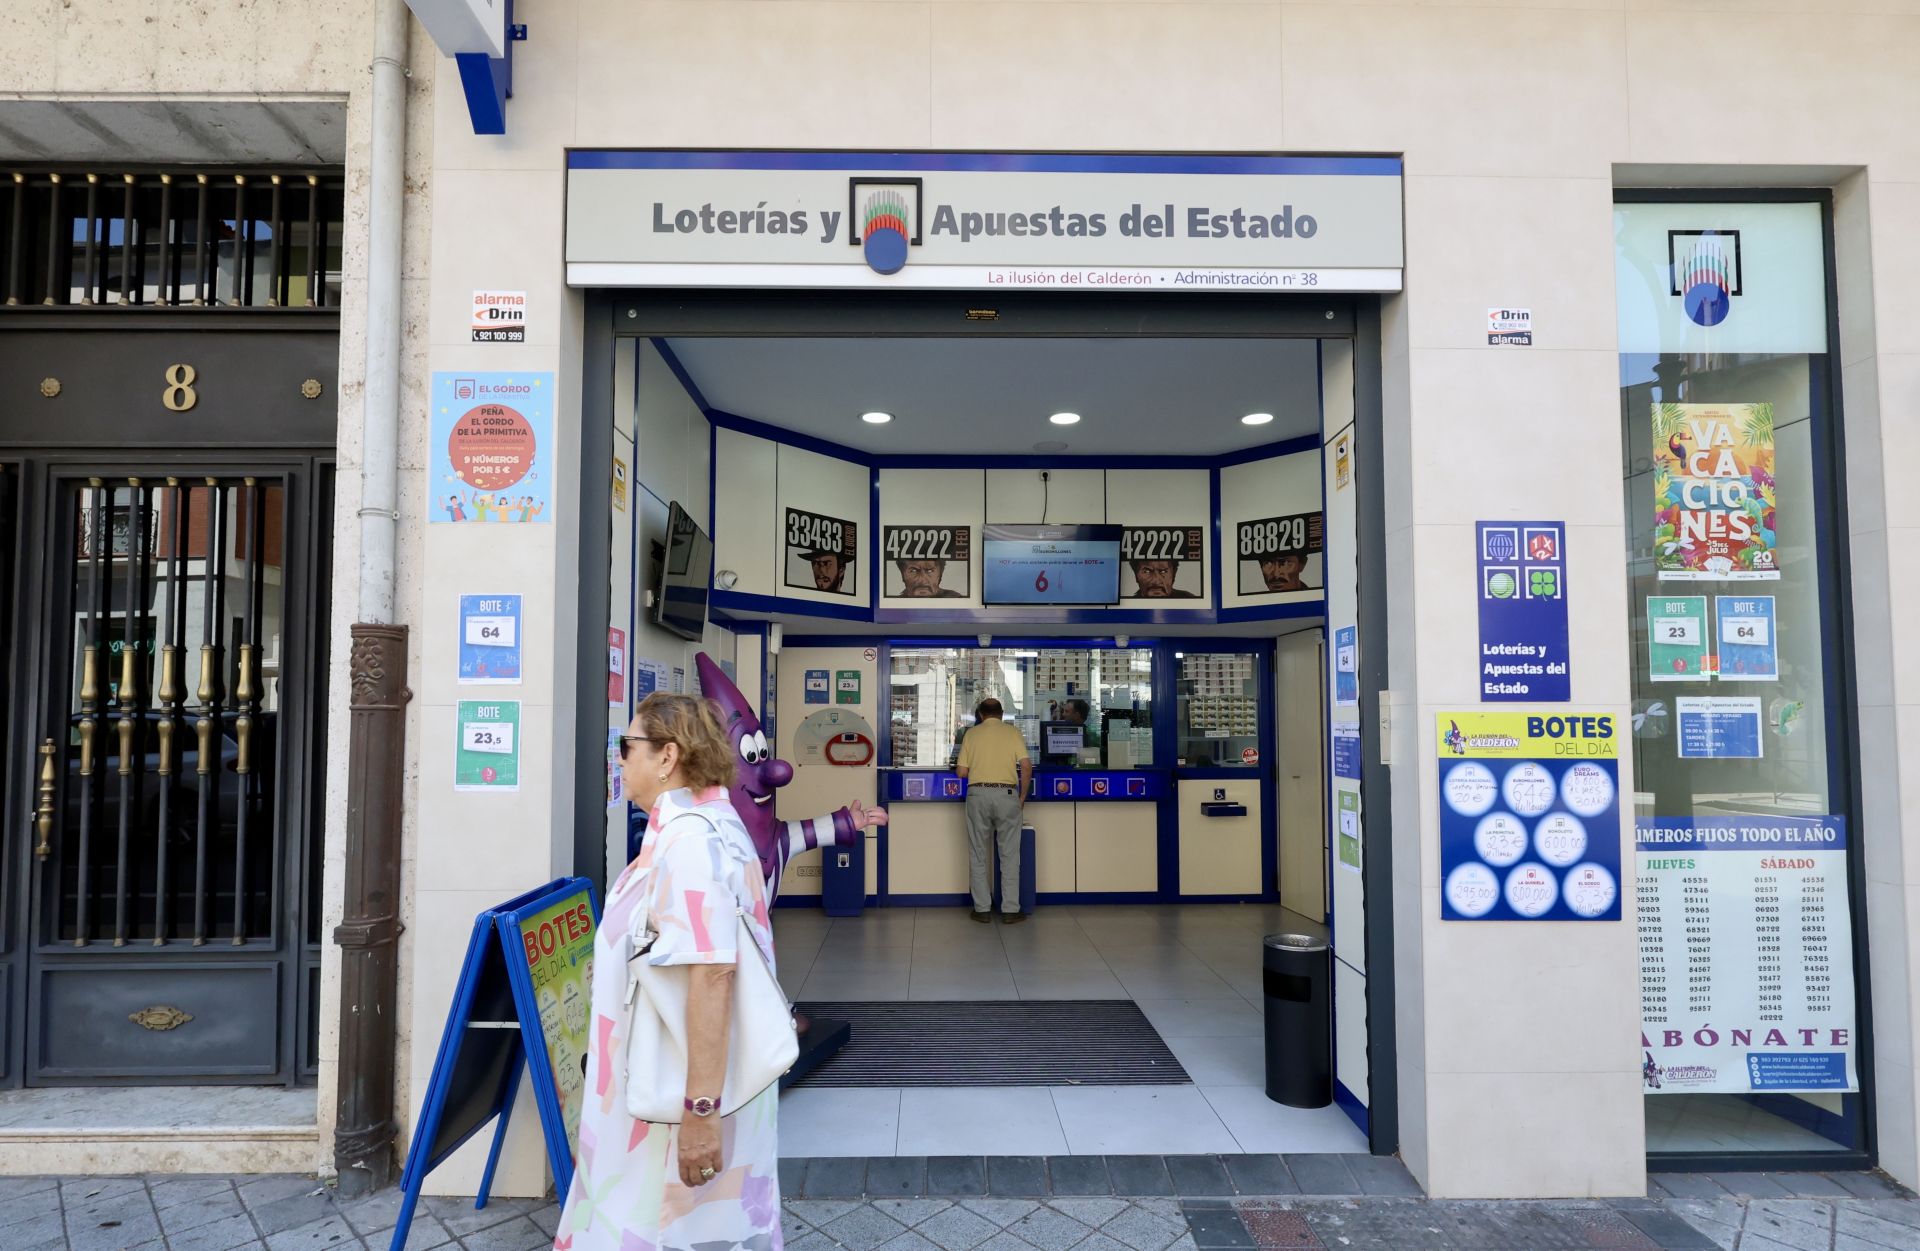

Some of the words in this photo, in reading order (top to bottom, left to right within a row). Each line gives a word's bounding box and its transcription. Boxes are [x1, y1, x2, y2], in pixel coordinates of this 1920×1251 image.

[652, 201, 808, 236] Loterías
[820, 210, 841, 243] y
[930, 204, 1107, 243] Apuestas
[1119, 203, 1175, 237] del
[1187, 205, 1318, 239] Estado
[988, 272, 1004, 284] La
[1009, 272, 1055, 284] ilusión
[1060, 272, 1083, 284] del
[1087, 272, 1152, 285] Calderón
[1174, 272, 1279, 286] Administración
[1301, 273, 1318, 286] 38
[474, 292, 524, 305] alarma
[488, 308, 523, 320] Drin
[1501, 310, 1529, 320] Drin
[479, 331, 493, 341] 921
[494, 331, 507, 341] 100
[509, 331, 523, 342] 999
[1491, 334, 1529, 344] alarma
[162, 363, 197, 411] 8
[481, 407, 504, 415] PEÑA
[1690, 421, 1735, 450] VA
[472, 454, 519, 463] NÚMEROS
[1690, 449, 1740, 478] CA
[1682, 480, 1747, 509] CIO
[1681, 510, 1751, 541] NES
[788, 513, 842, 553] 33433
[955, 529, 968, 547] FEO
[1188, 530, 1200, 547] FEO
[1240, 518, 1305, 556] 88829
[886, 529, 952, 559] 42222
[1121, 530, 1184, 560] 42222
[1532, 538, 1538, 549] 1
[955, 549, 968, 559] EL
[1188, 551, 1200, 559] EL
[1753, 551, 1772, 563] 20
[480, 600, 501, 612] BOTE
[1666, 602, 1686, 613] BOTE
[1734, 602, 1754, 613] BOTE
[481, 627, 500, 638] 64
[1669, 627, 1686, 638] 23
[1737, 627, 1754, 637] 64
[1483, 644, 1536, 655] Loterías
[1538, 646, 1546, 658] y
[1342, 656, 1349, 666] 64
[1484, 664, 1544, 677] Apuestas
[1546, 662, 1566, 674] del
[1485, 682, 1529, 694] Estado
[478, 706, 500, 719] BOTE
[1527, 717, 1613, 738] BOTES
[474, 733, 501, 745] 23,5
[1555, 743, 1583, 755] DEL
[1588, 740, 1612, 755] DÍA
[1513, 784, 1535, 804] 64
[1696, 829, 1737, 842] FIJOS
[1740, 828, 1781, 842] TODO
[1785, 829, 1801, 842] EL
[1804, 825, 1836, 842] AÑO
[1647, 859, 1695, 869] JUEVES
[1761, 856, 1815, 869] SÁBADO
[523, 903, 591, 966] BOTES
[530, 967, 551, 991] DEL
[550, 953, 567, 977] DÍA
